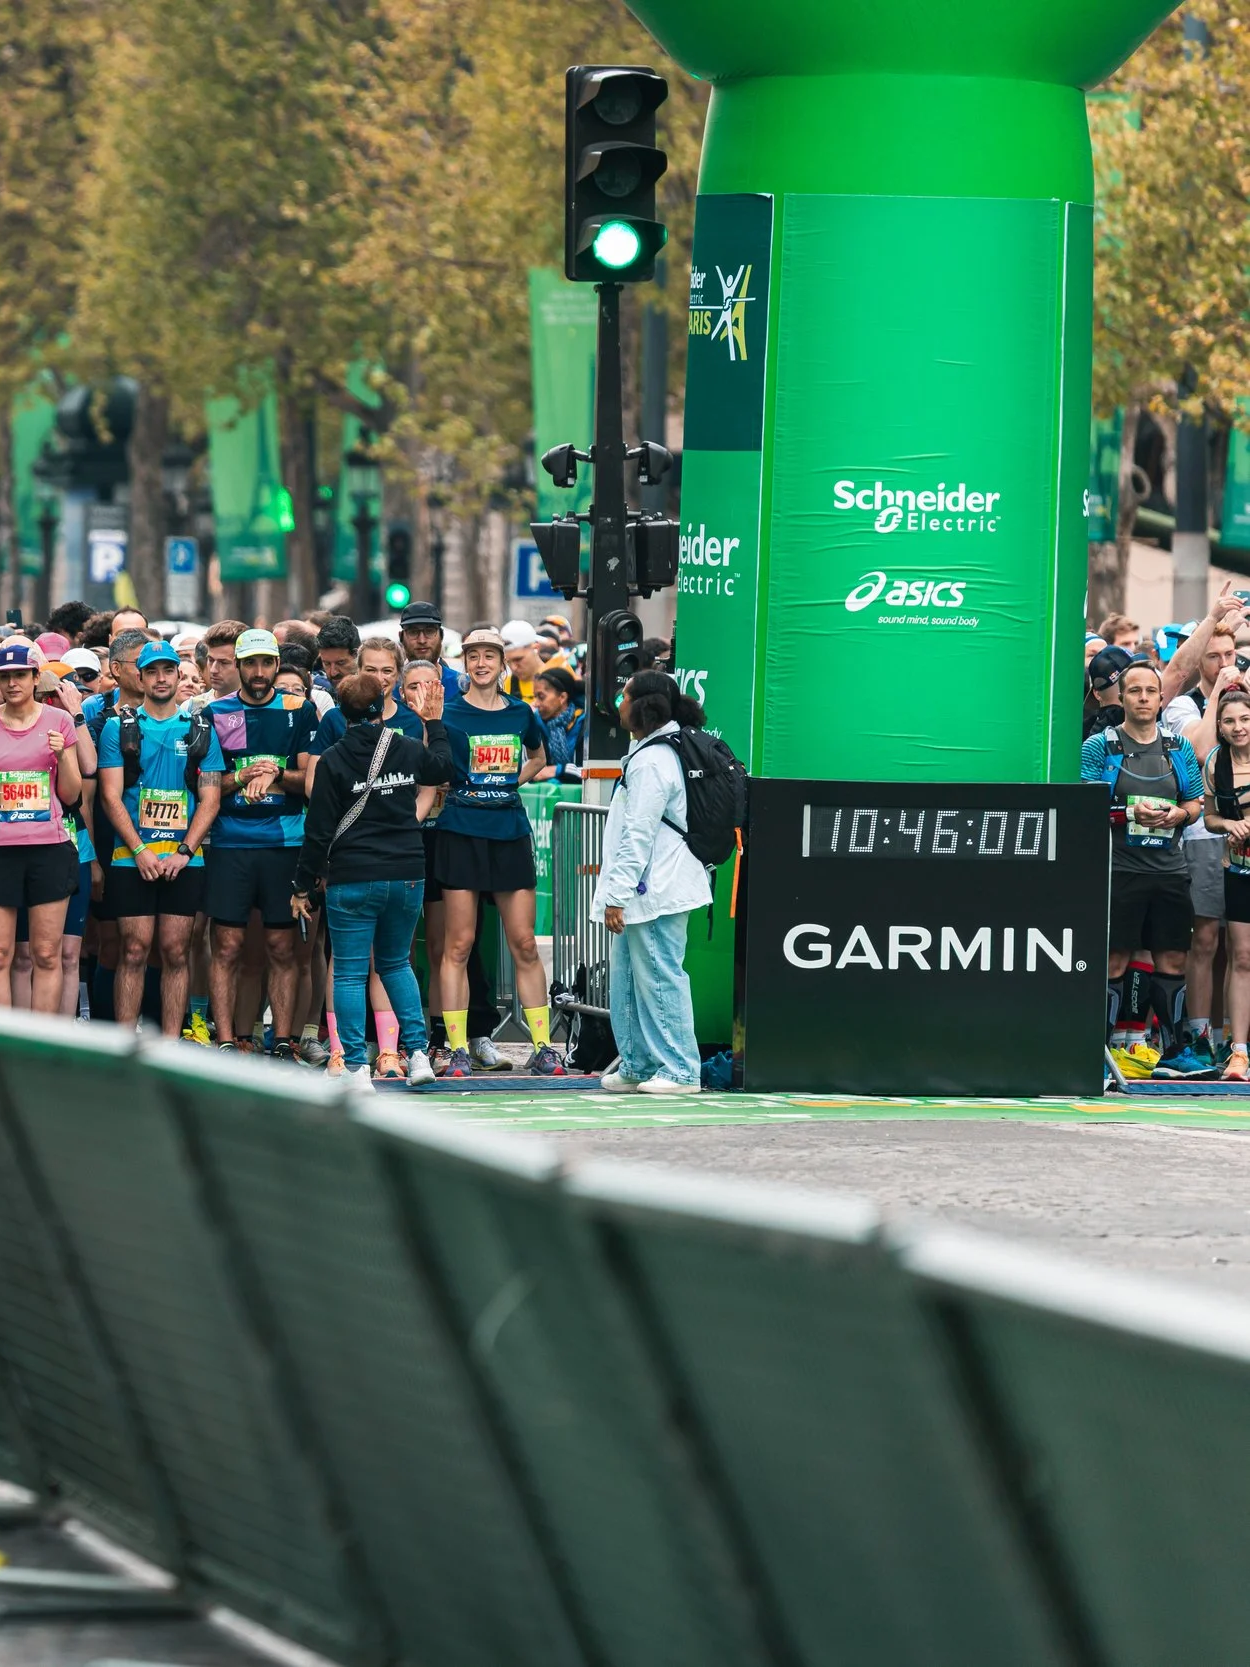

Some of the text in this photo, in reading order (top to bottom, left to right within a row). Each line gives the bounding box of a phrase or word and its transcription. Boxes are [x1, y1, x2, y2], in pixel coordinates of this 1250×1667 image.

[833, 480, 1001, 513] Schneider
[679, 523, 741, 567] eider
[877, 615, 906, 624] sound
[931, 616, 958, 625] sound
[958, 616, 980, 628] body
[477, 747, 510, 764] 54714
[2, 784, 38, 801] 56491
[145, 801, 180, 819] 47772
[831, 809, 1044, 855] 10:46:00
